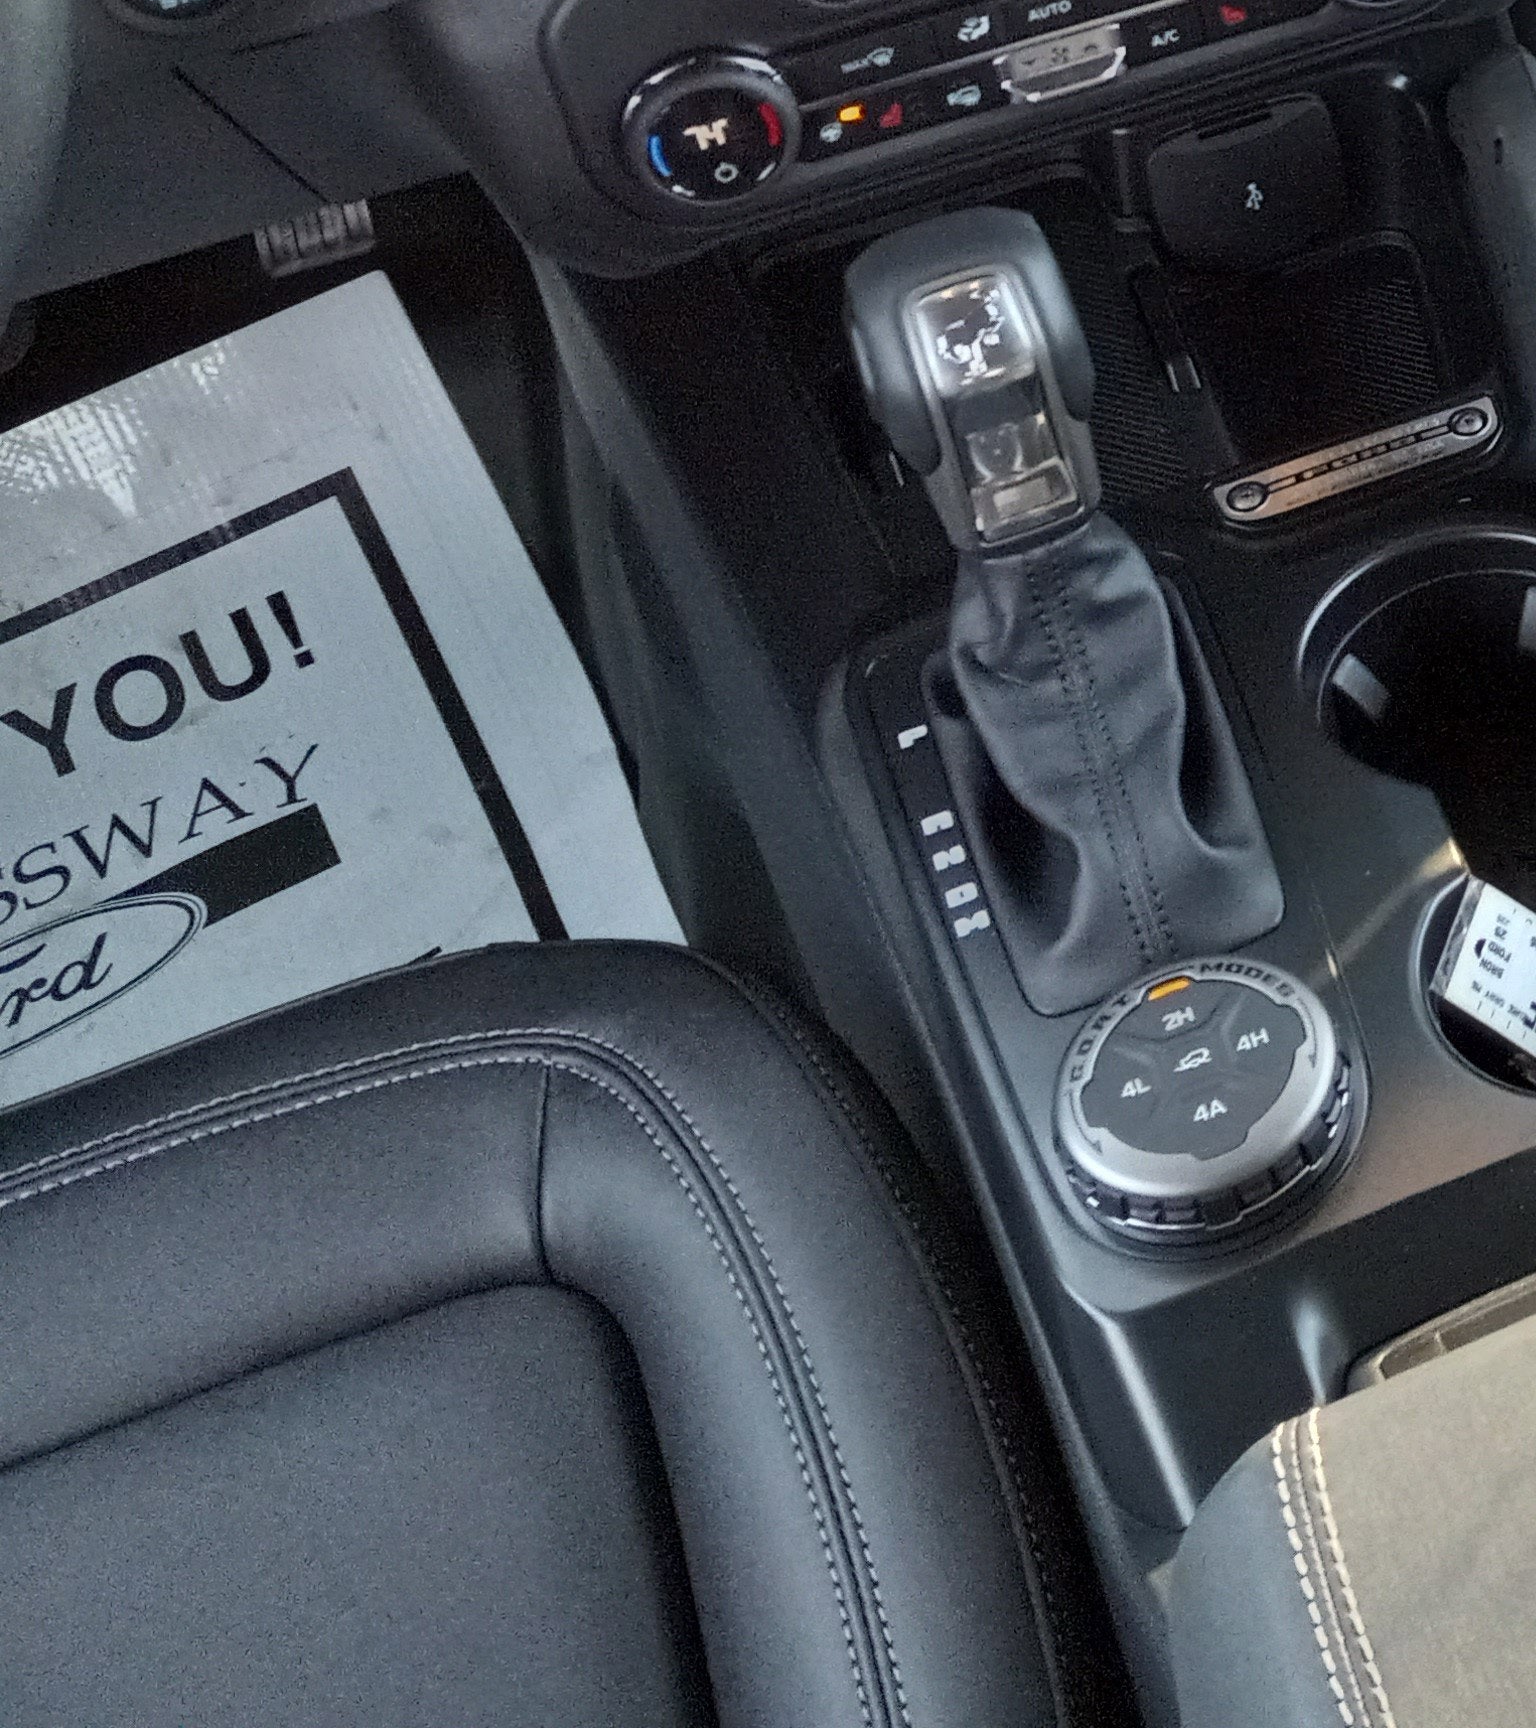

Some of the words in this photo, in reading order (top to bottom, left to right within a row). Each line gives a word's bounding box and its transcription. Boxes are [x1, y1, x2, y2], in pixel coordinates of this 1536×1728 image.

[1027, 0, 1072, 22] AUTO
[1151, 28, 1180, 47] A/C
[0, 590, 316, 777] YOU!
[897, 724, 928, 749] P
[1487, 941, 1513, 963] FORD
[1200, 961, 1297, 998] MODES
[1161, 1006, 1196, 1032] 2H
[1235, 1027, 1271, 1052] 4H
[1119, 1077, 1151, 1098] 4L
[1192, 1097, 1228, 1122] 4A
